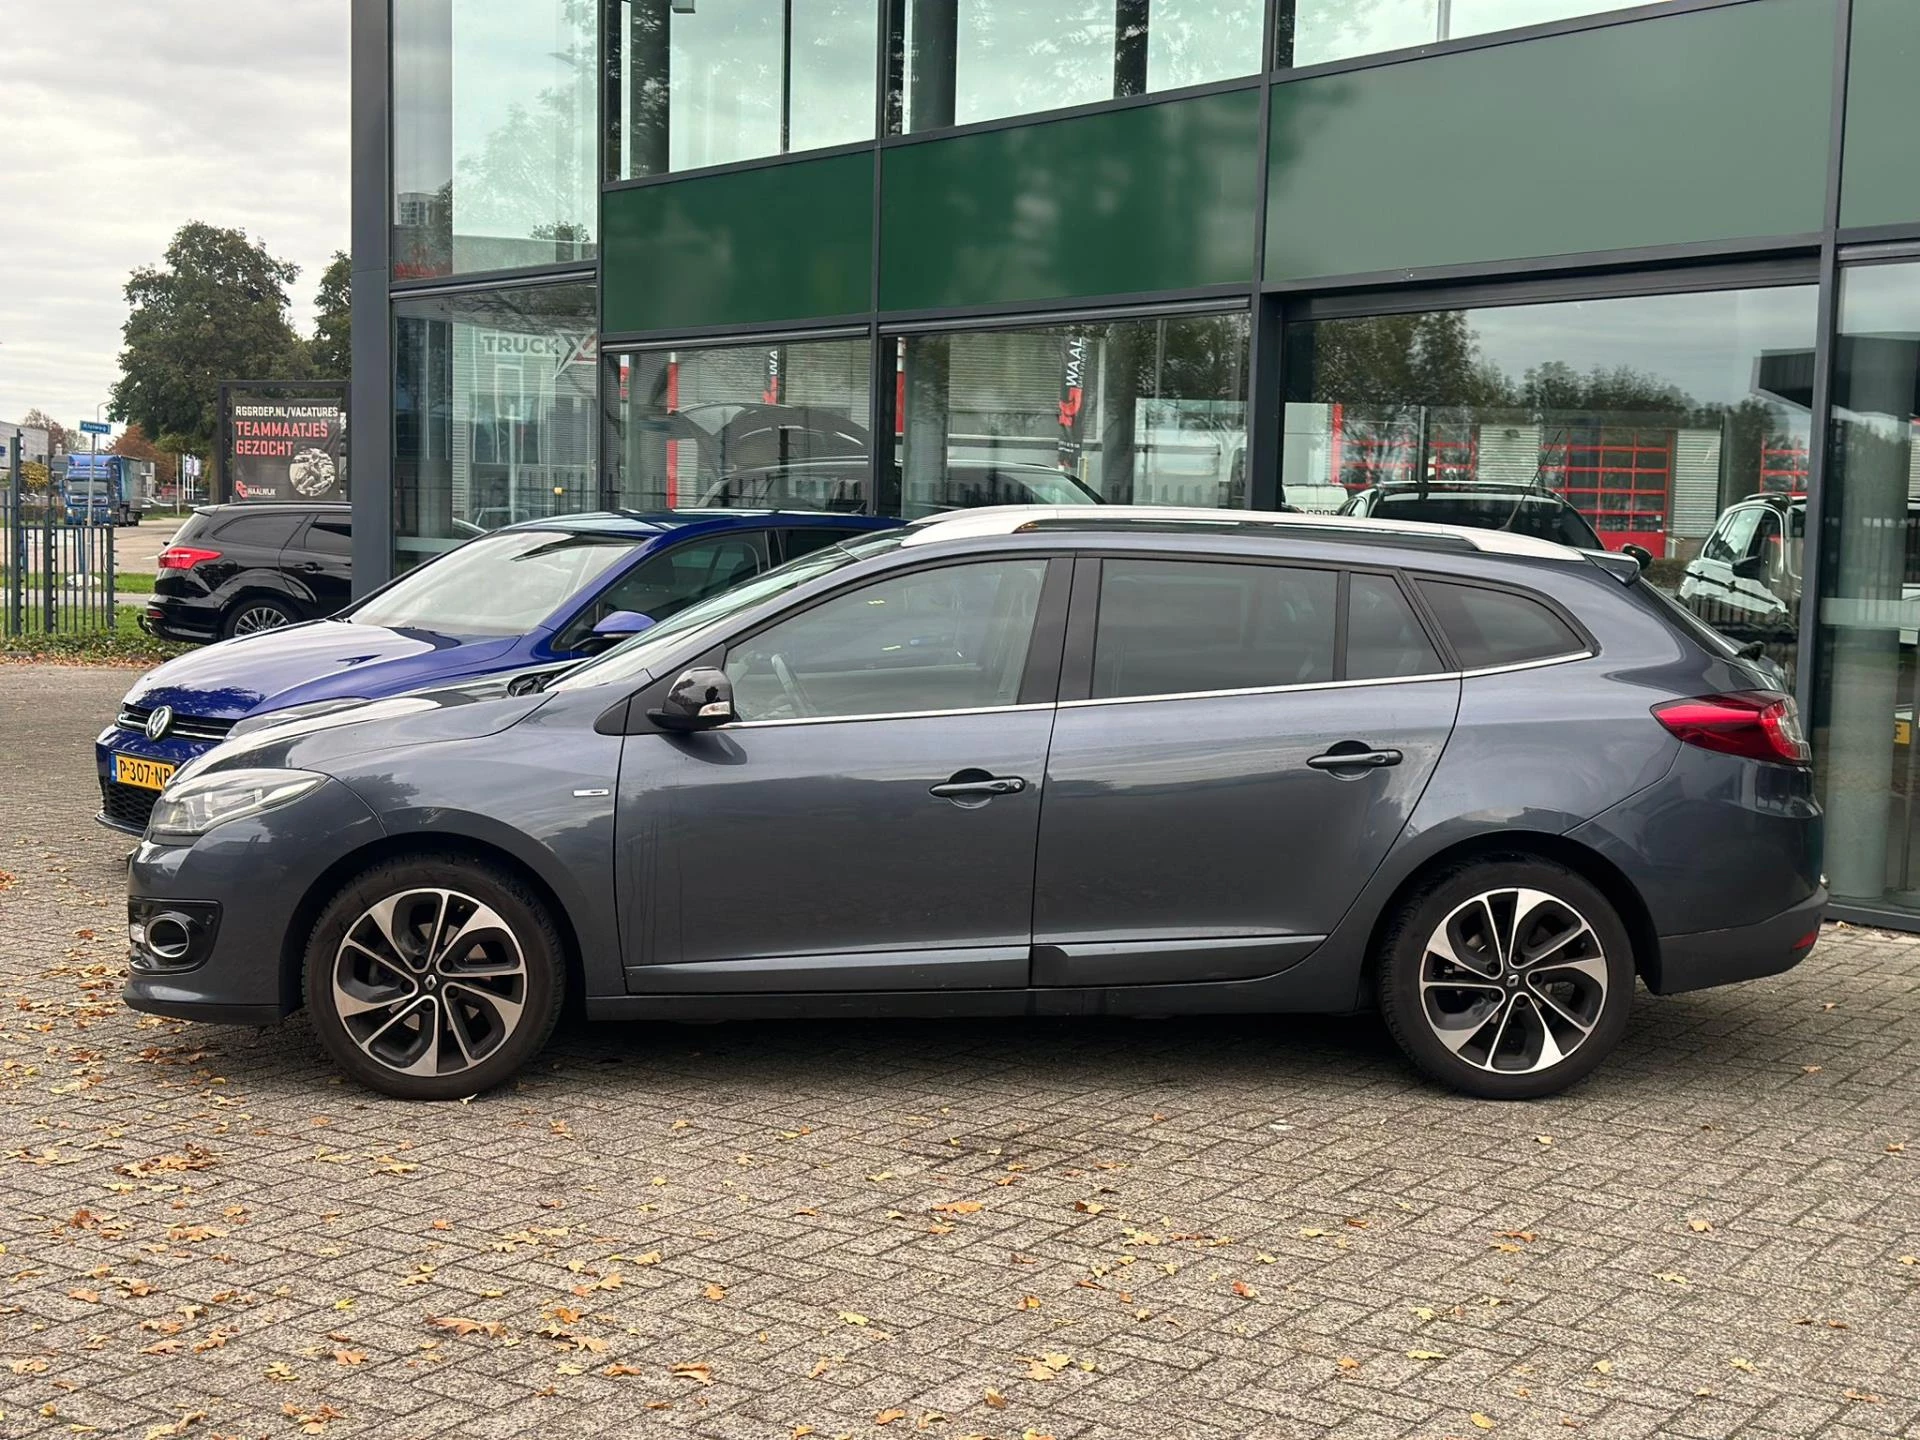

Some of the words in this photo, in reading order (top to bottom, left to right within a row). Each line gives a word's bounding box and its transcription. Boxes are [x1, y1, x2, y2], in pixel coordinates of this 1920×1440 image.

[482, 335, 558, 354] TRUCK
[235, 405, 339, 418] RGGROEP.NL/VACATURES
[235, 421, 329, 438] TEAMMAATJES
[236, 439, 294, 456] GEZOCHT
